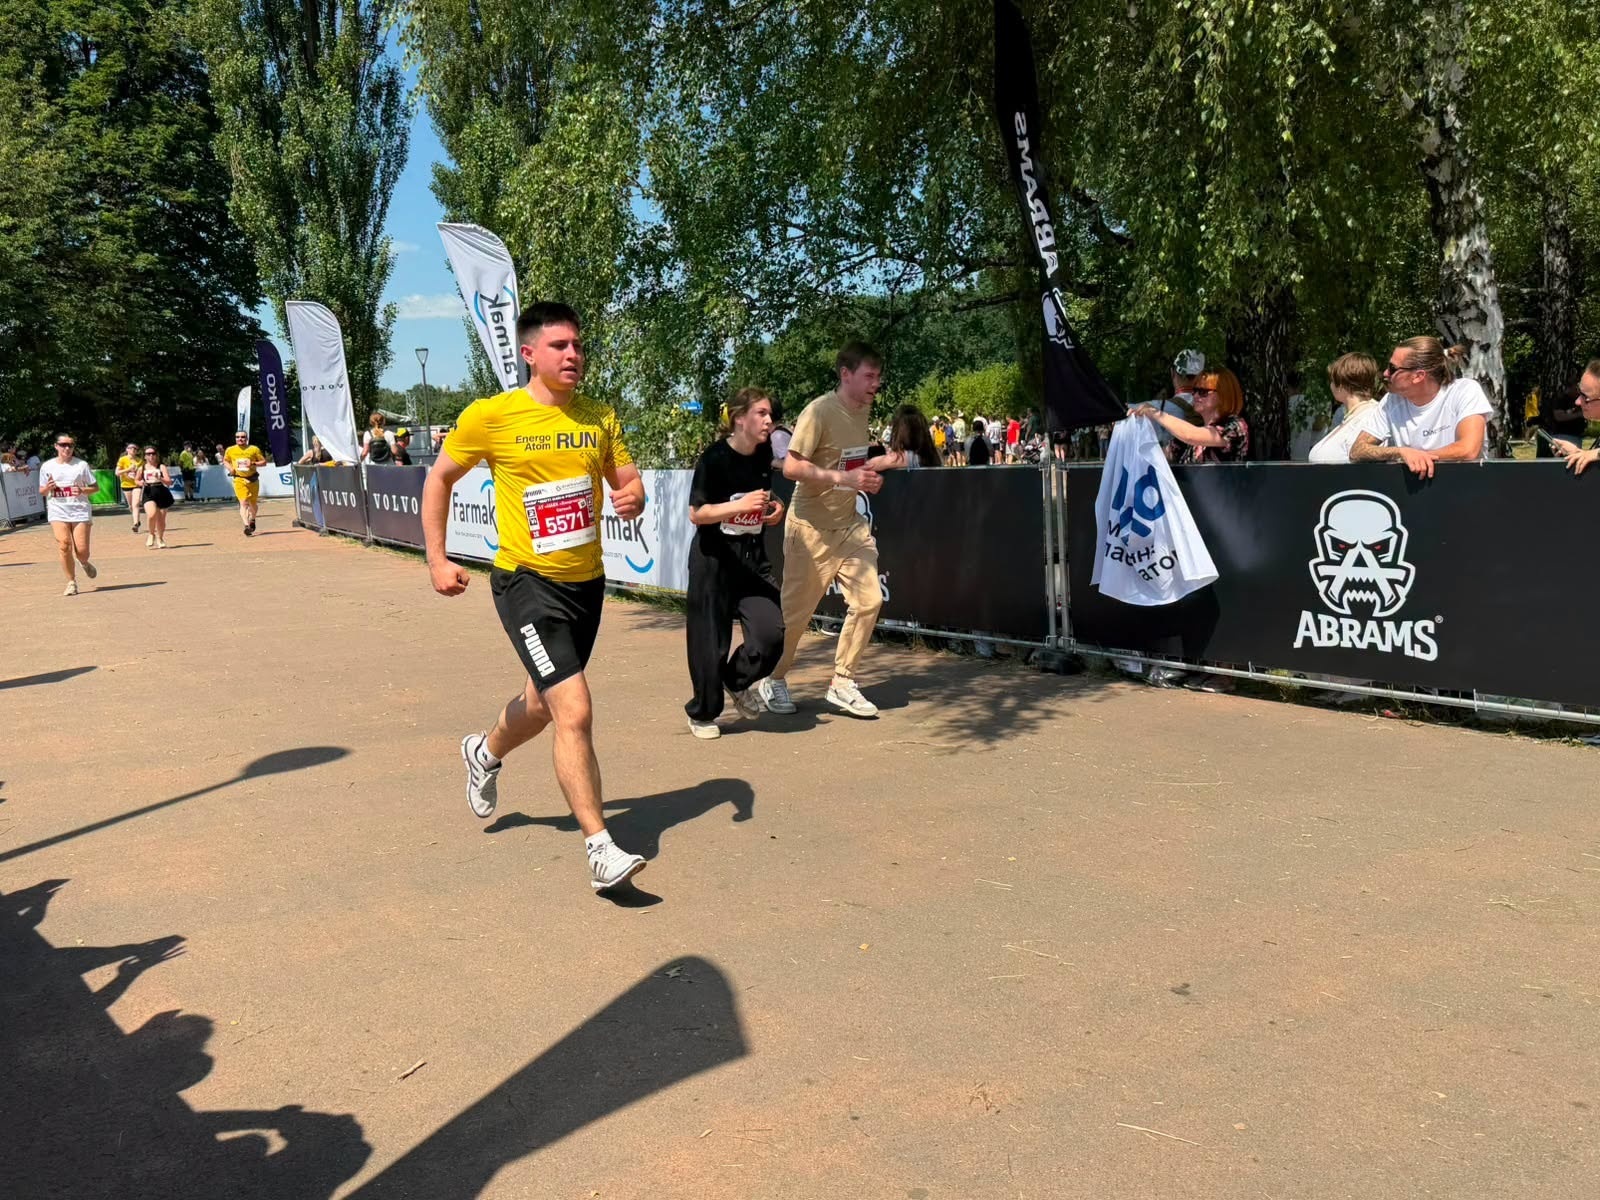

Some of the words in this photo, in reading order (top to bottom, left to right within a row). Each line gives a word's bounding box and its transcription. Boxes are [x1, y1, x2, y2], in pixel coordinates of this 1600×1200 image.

[515, 434, 551, 444] Energo
[524, 442, 551, 451] Atom
[556, 431, 597, 449] RUN
[322, 489, 357, 508] VOLVO
[373, 492, 419, 515] VOLVO
[452, 488, 499, 535] Farmak
[545, 510, 586, 534] 5571
[605, 514, 649, 554] mak
[519, 622, 556, 678] PUMA
